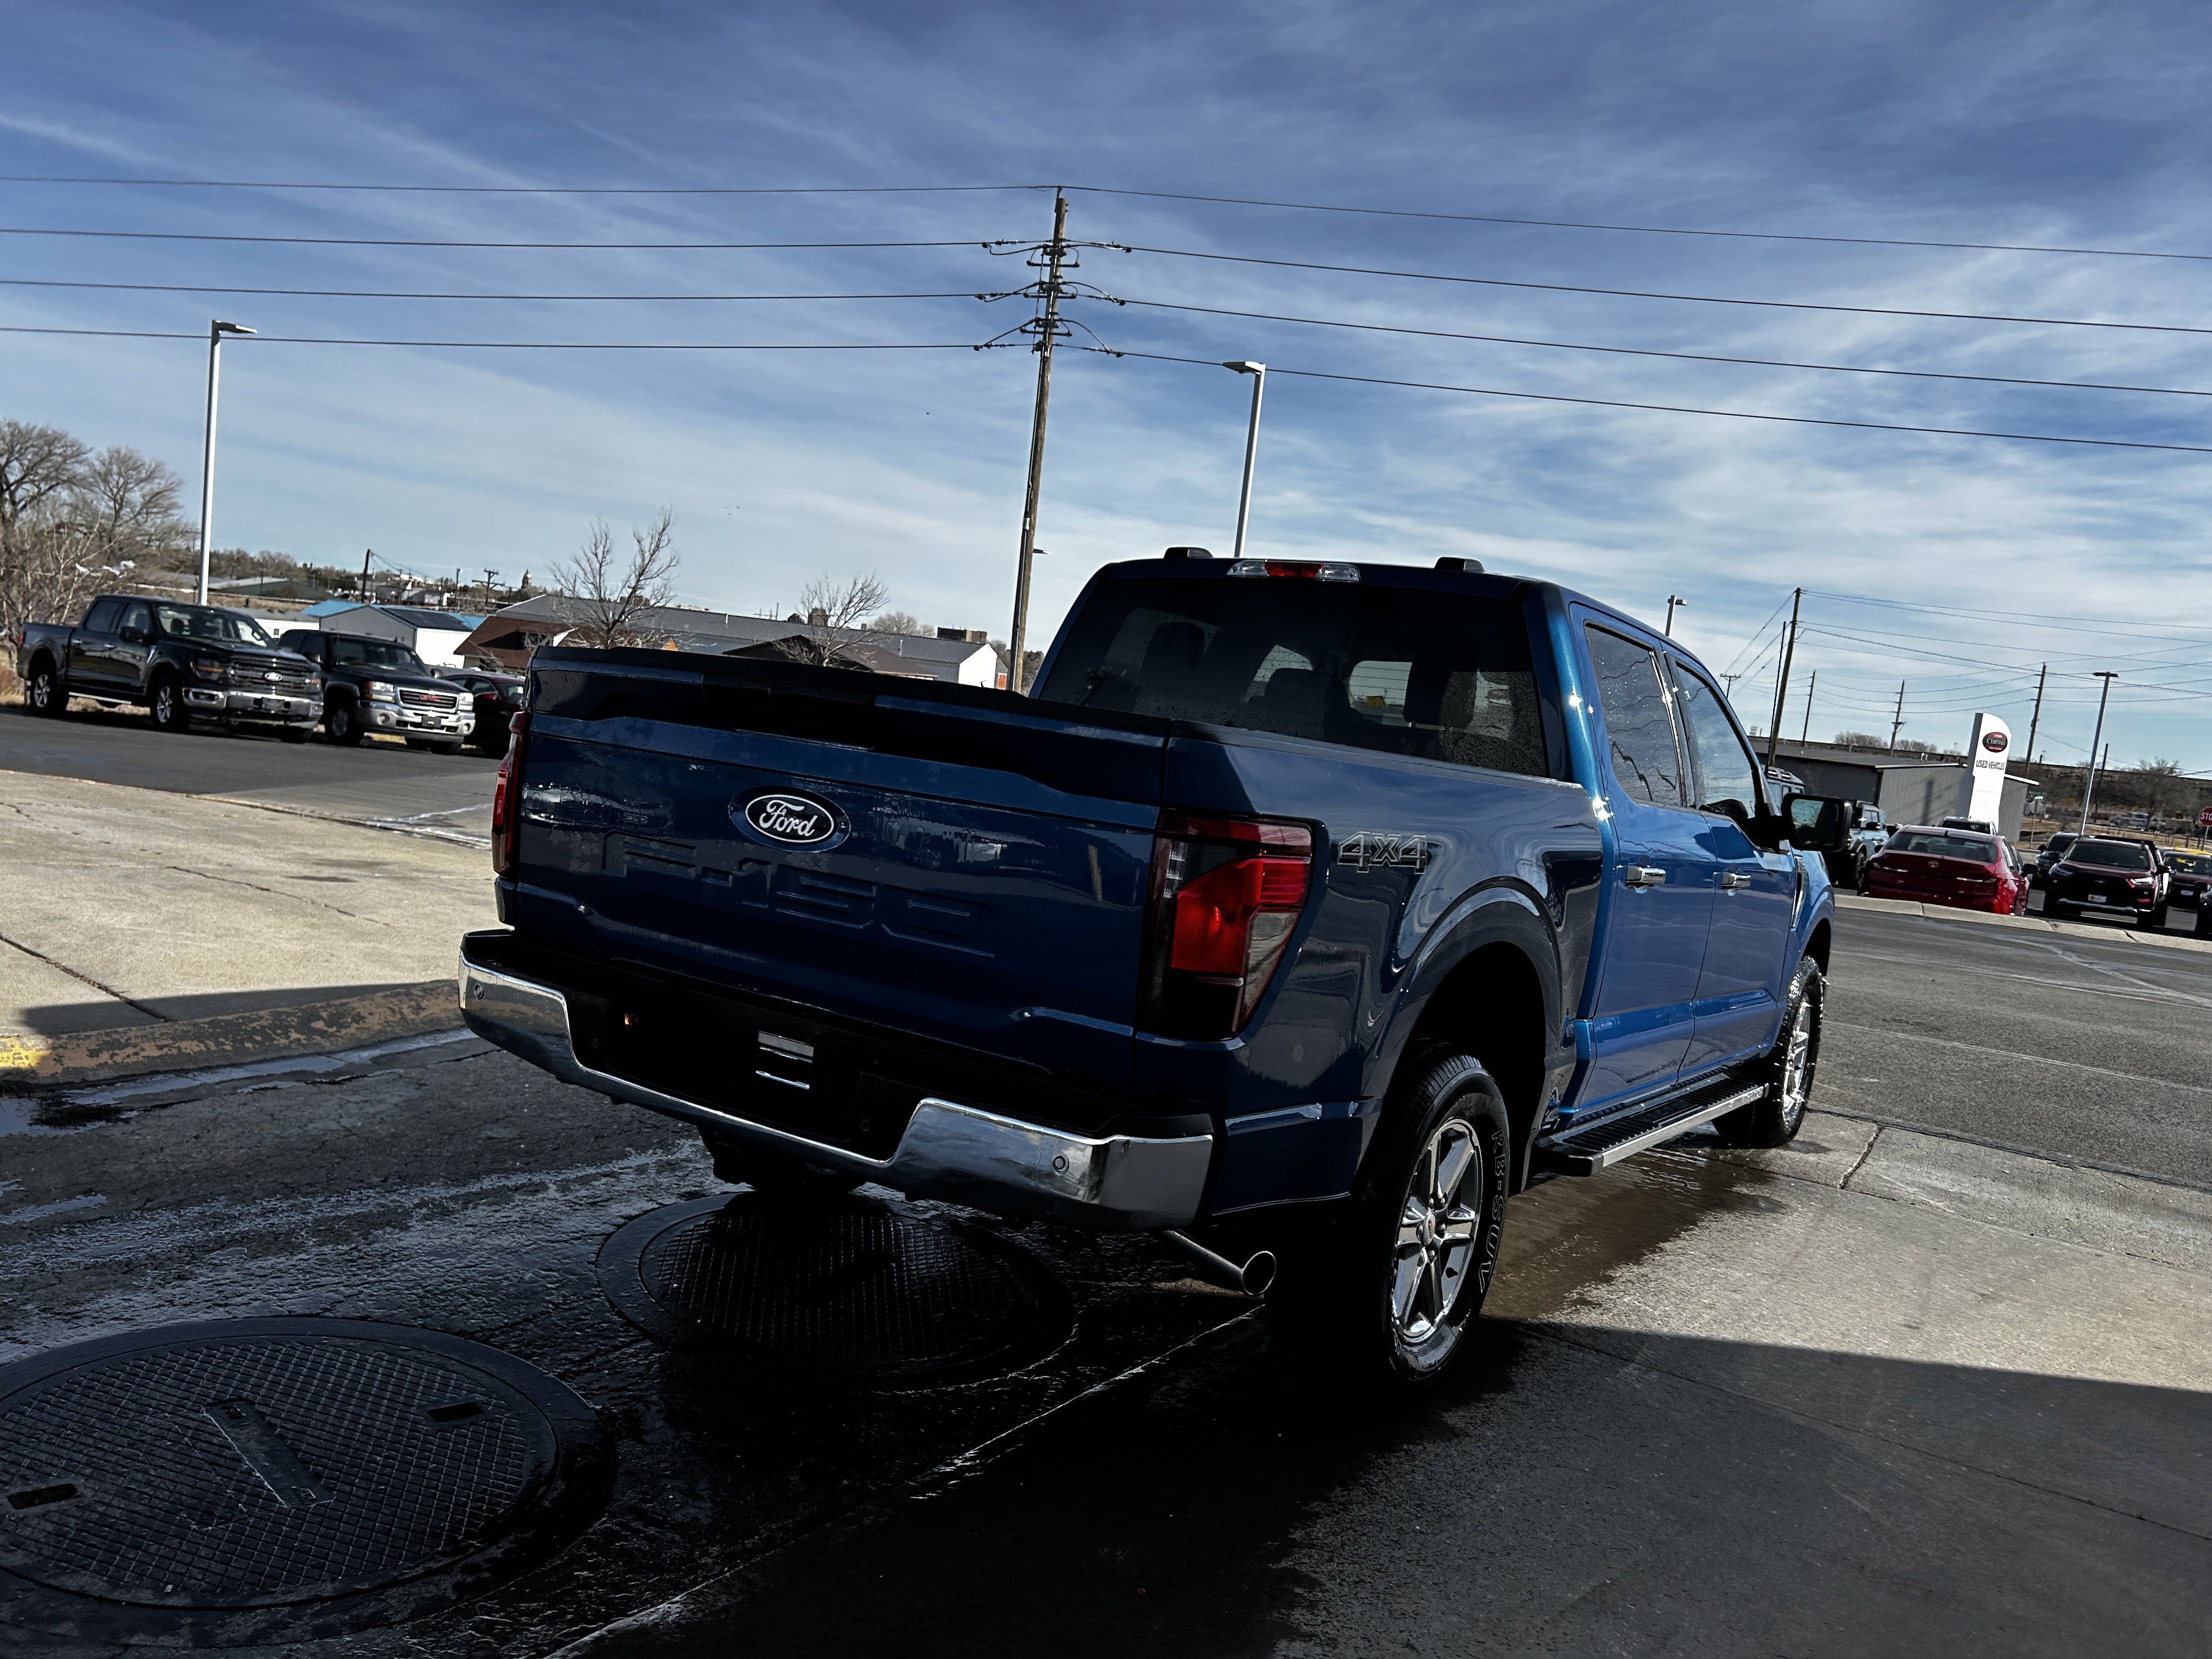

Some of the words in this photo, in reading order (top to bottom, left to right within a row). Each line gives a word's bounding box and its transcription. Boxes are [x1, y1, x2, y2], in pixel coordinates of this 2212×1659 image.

[1976, 760, 1988, 768] USED
[759, 799, 818, 837] Ford
[2200, 812, 2212, 820] STO
[1478, 1129, 1506, 1294] RB-SUV
